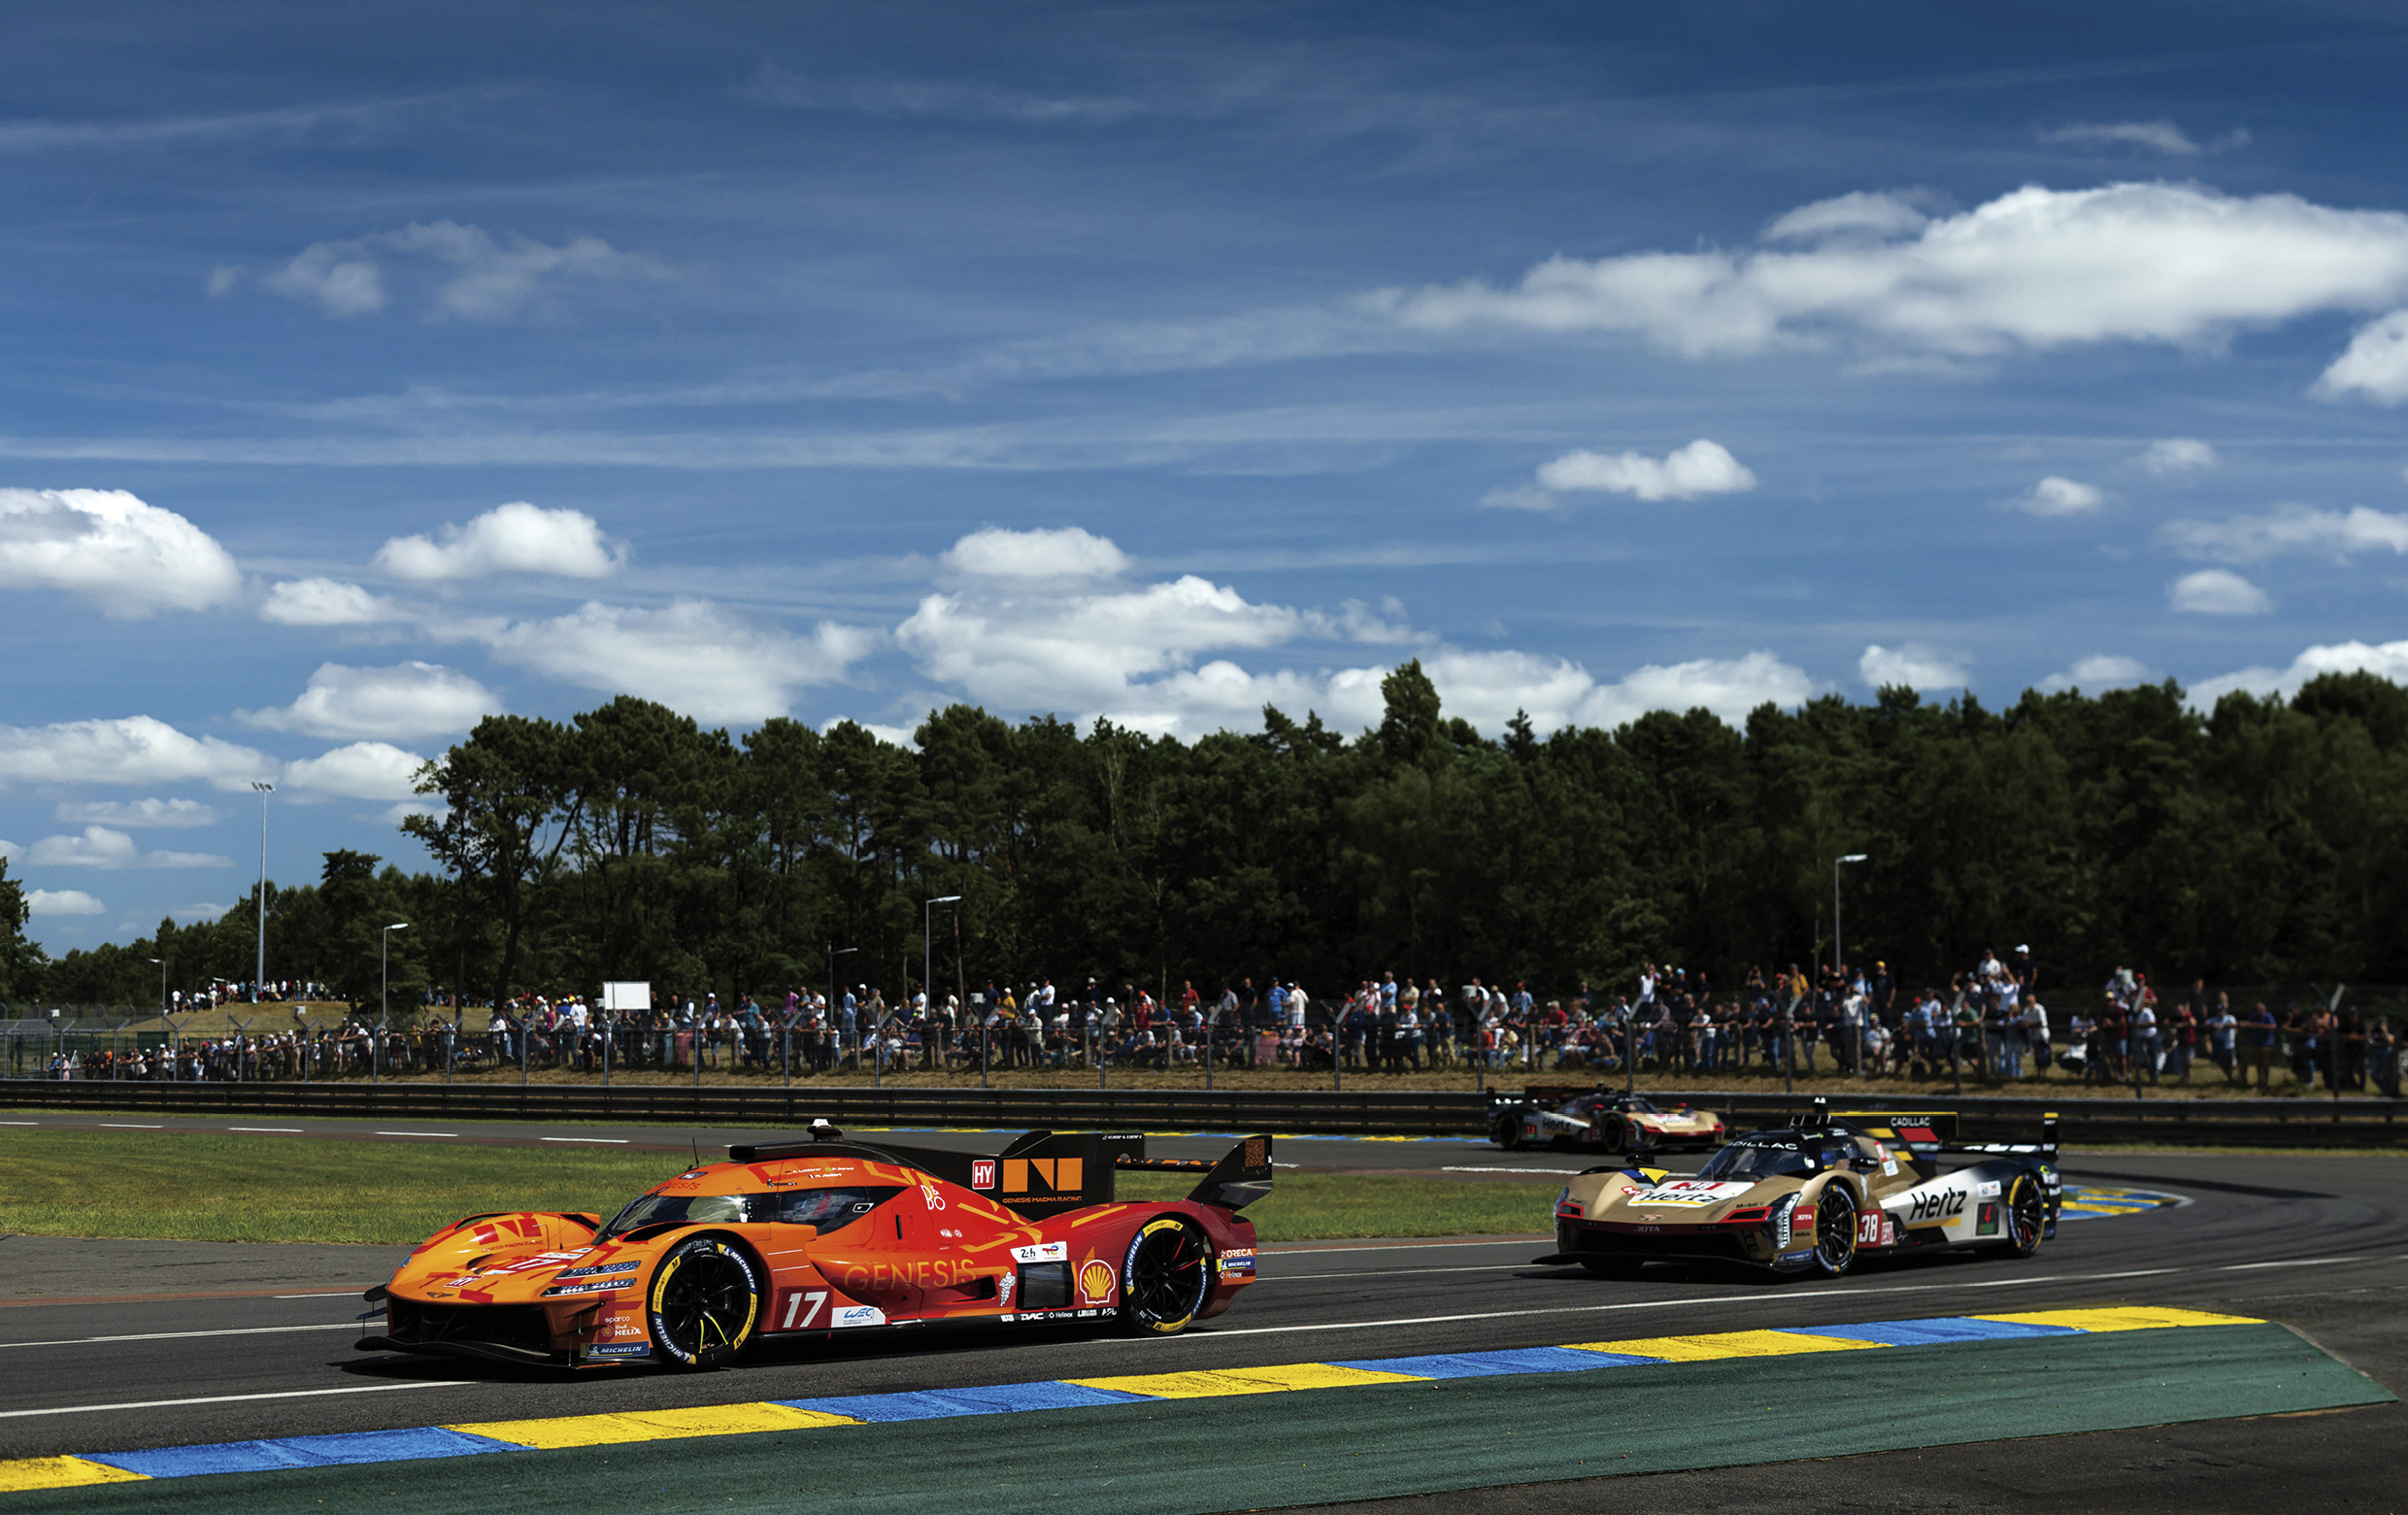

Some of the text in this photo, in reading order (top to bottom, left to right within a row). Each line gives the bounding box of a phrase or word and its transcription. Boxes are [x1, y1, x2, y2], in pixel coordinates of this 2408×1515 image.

[1890, 1118, 1930, 1127] CADILLAC
[1727, 1141, 1798, 1151] ADILLAC
[974, 1165, 992, 1184] HY
[1639, 1192, 1719, 1202] Hertz
[1909, 1187, 1967, 1221] Hertz
[1984, 1204, 1991, 1223] 4
[1857, 1213, 1879, 1243] 38
[1126, 1234, 1143, 1278] MICHELIN
[1226, 1248, 1253, 1258] ORECA
[730, 1251, 755, 1289] MICHELIN
[844, 1259, 976, 1292] GENESIS
[783, 1292, 828, 1329] 17
[844, 1307, 874, 1319] WEC
[1020, 1312, 1045, 1321] DAC
[1055, 1309, 1073, 1319] Helinox
[615, 1326, 642, 1336] HELIX
[654, 1318, 684, 1358] MICHELIN
[600, 1345, 642, 1354] MICHELIN
